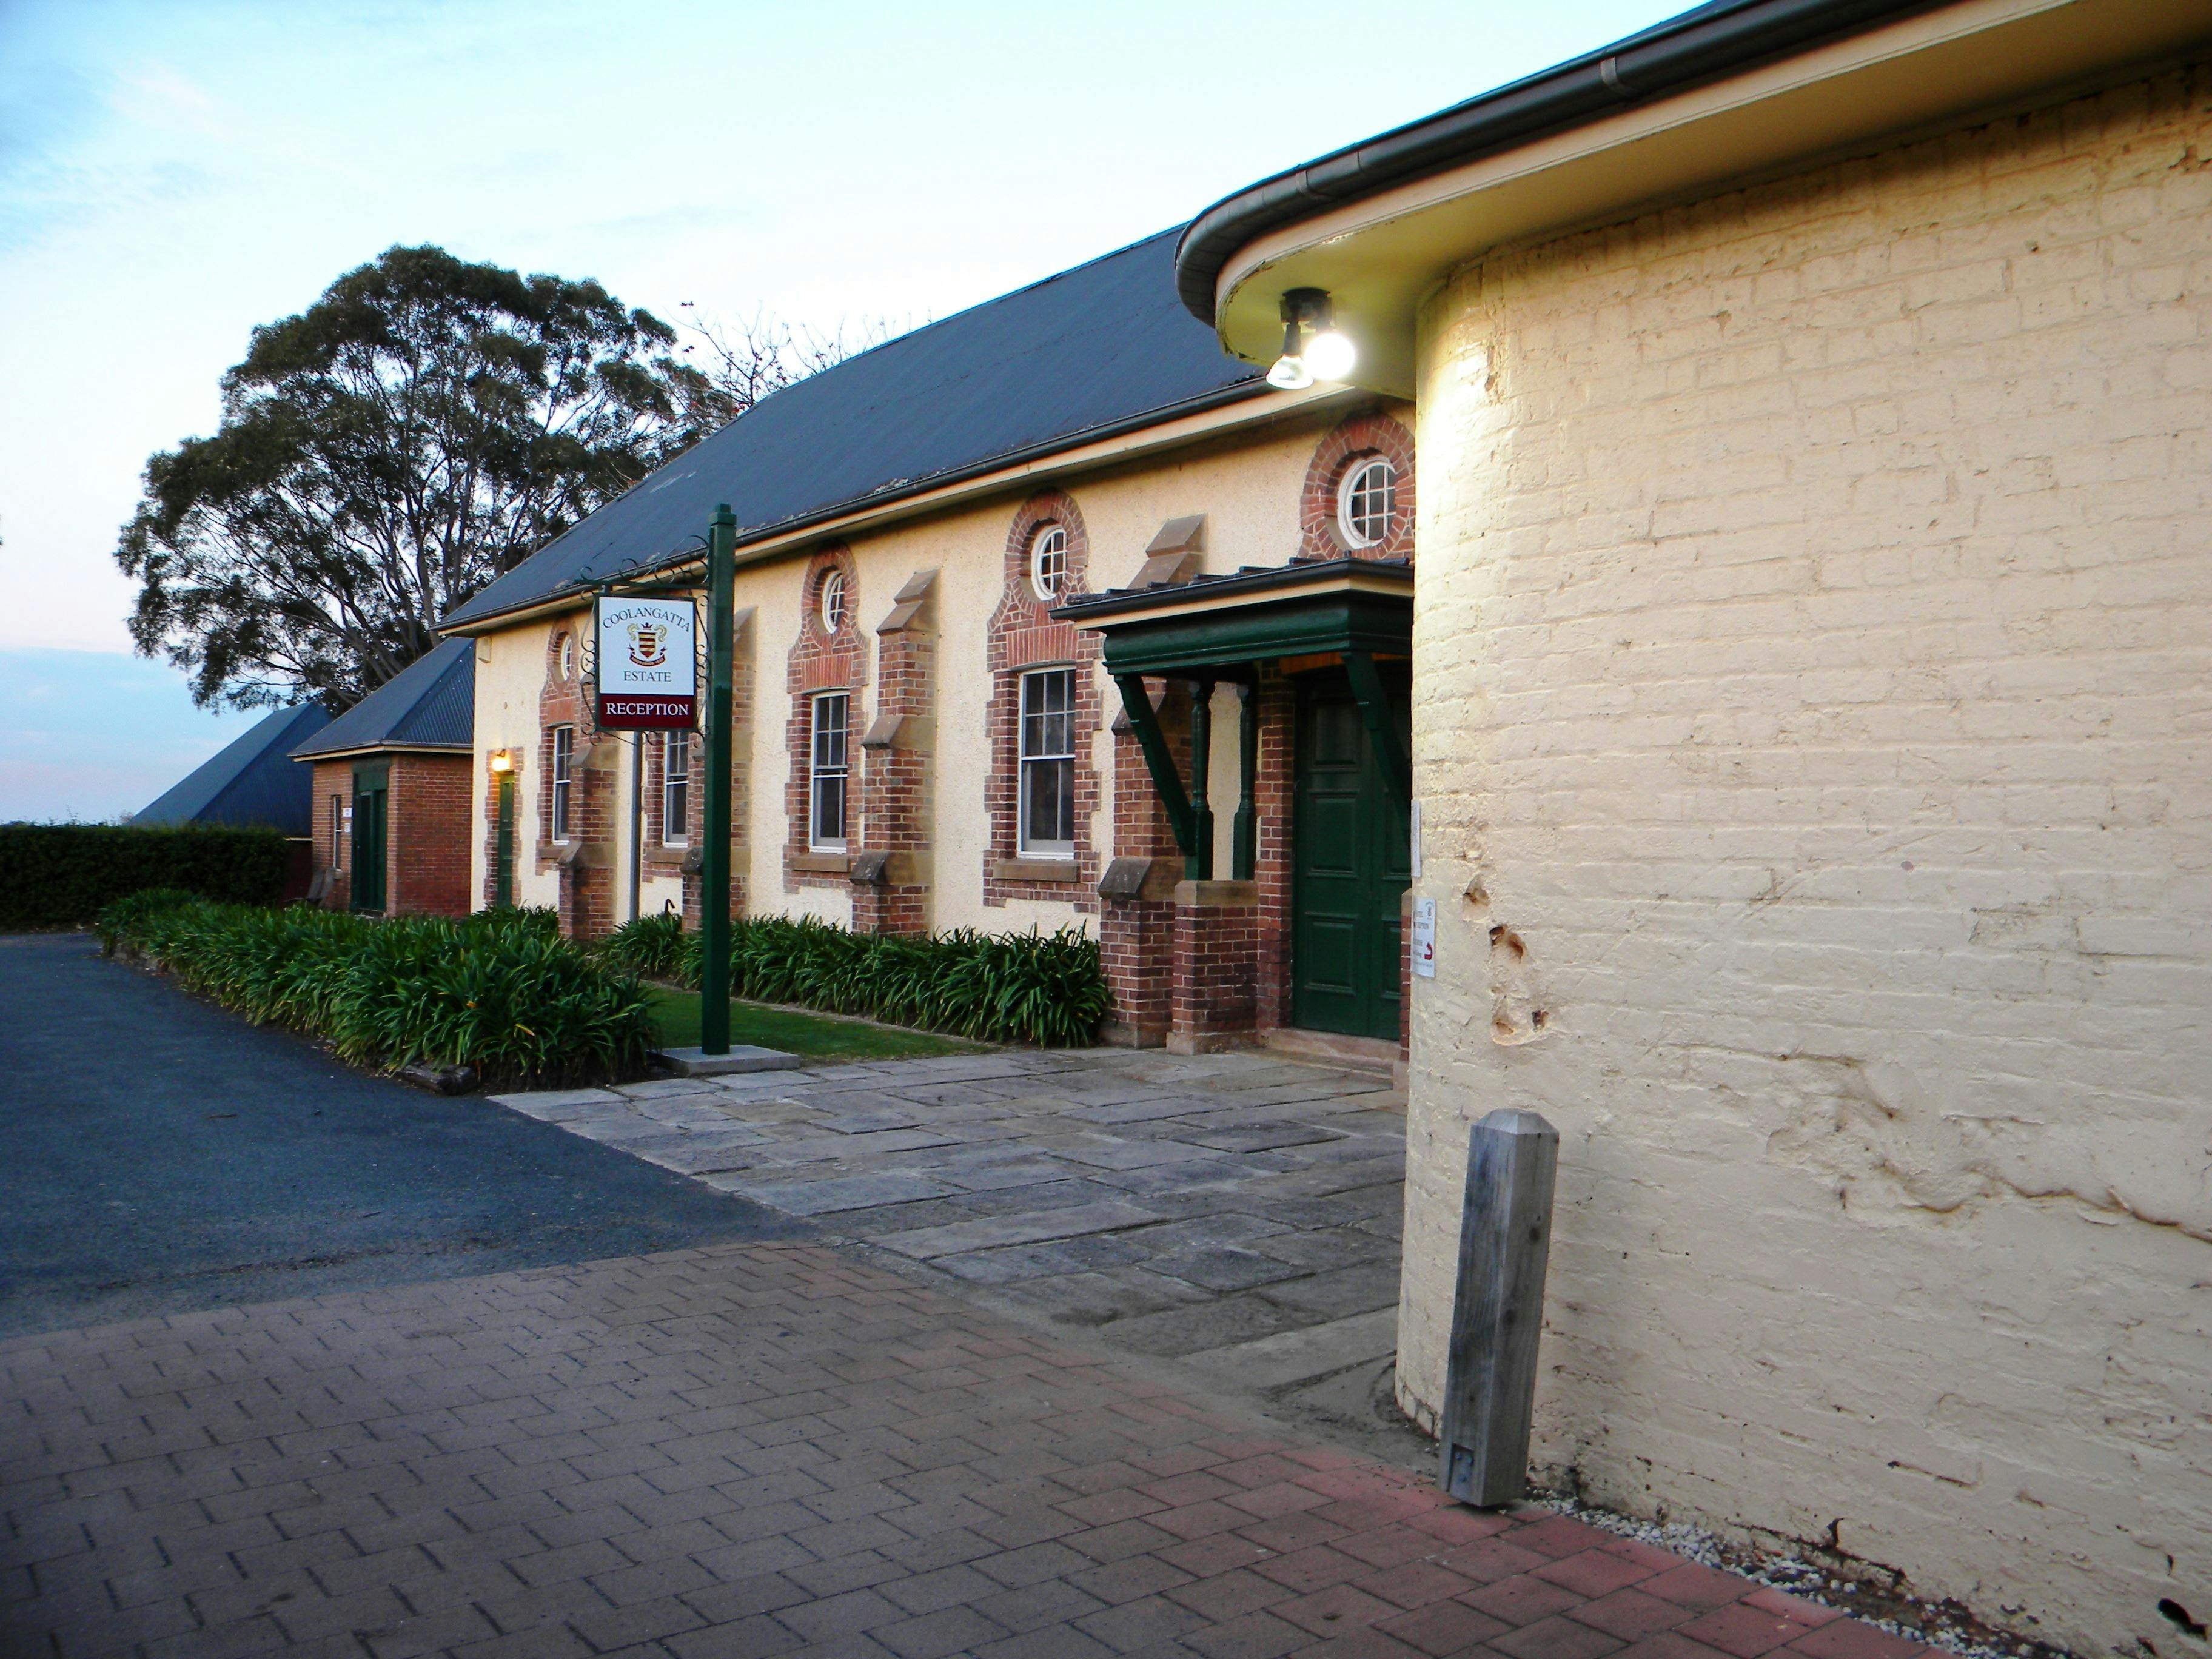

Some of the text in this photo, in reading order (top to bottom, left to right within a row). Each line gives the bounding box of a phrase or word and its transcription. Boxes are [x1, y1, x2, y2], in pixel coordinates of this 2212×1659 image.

[603, 607, 690, 632] COOLANGATTA
[623, 671, 672, 682] ESTATE
[606, 703, 689, 716] RECEPTION
